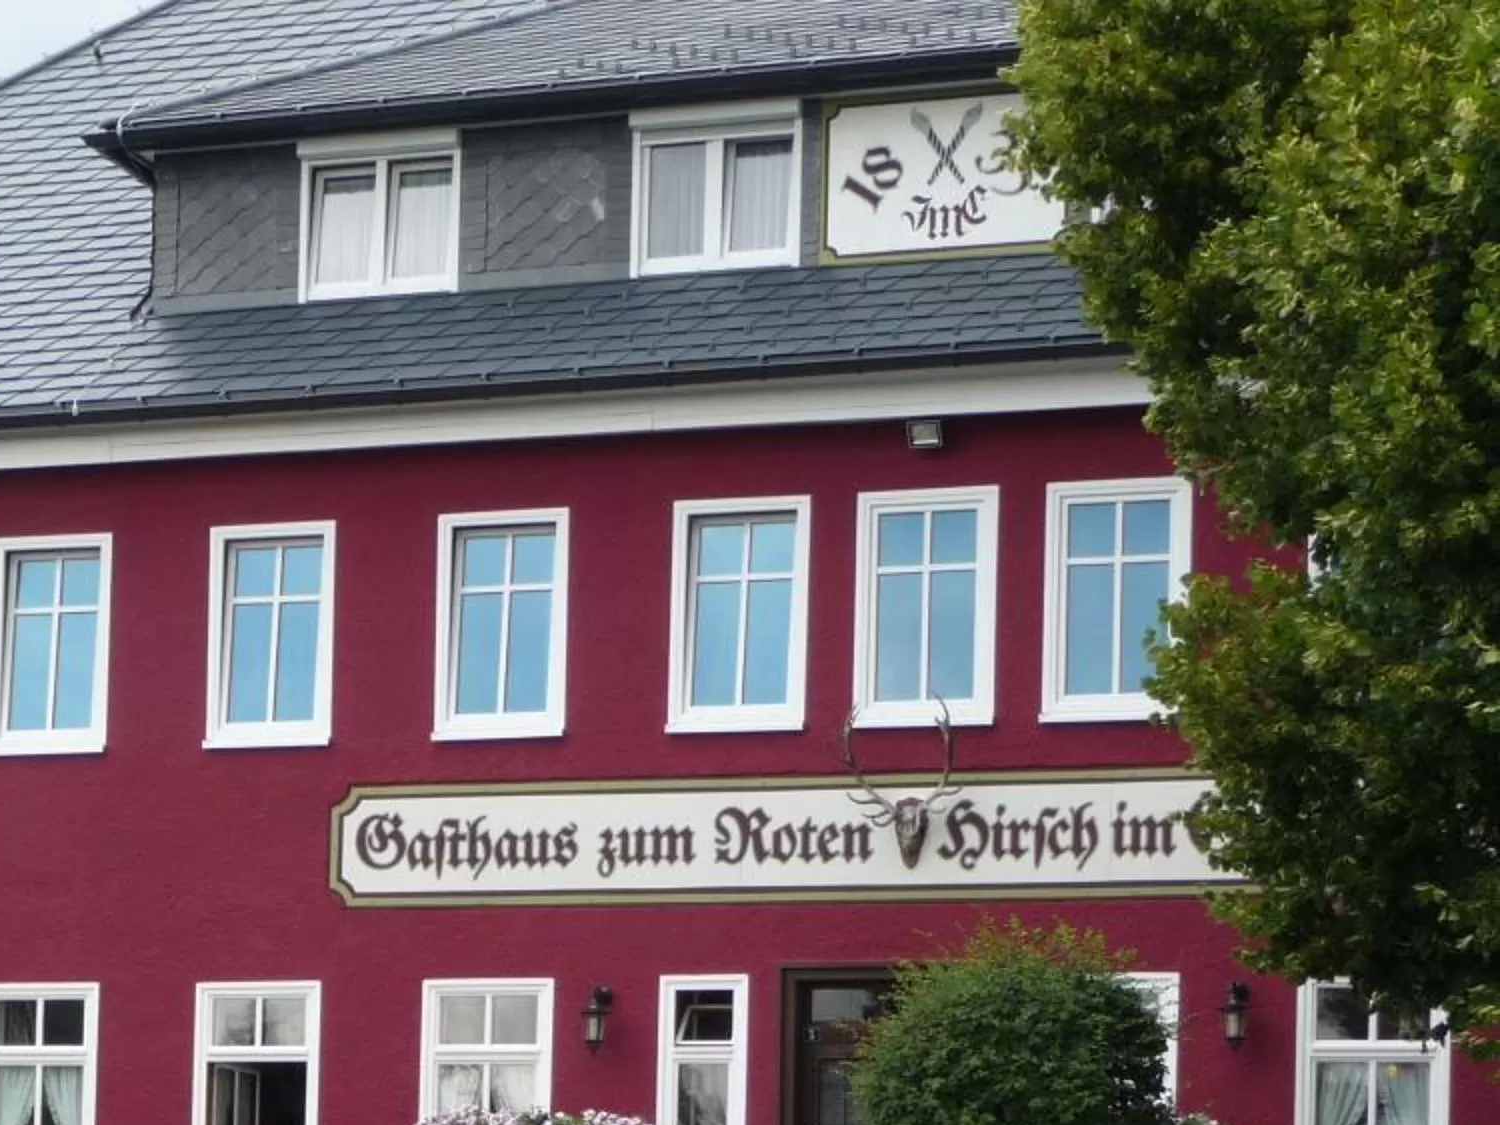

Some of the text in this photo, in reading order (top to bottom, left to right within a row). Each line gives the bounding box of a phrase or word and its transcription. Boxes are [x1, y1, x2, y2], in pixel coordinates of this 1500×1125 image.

[355, 812, 579, 882] Gasthaus
[596, 825, 697, 878] zum
[714, 806, 874, 865] Roten
[936, 799, 1100, 872] Hirsch
[1112, 800, 1178, 859] im
